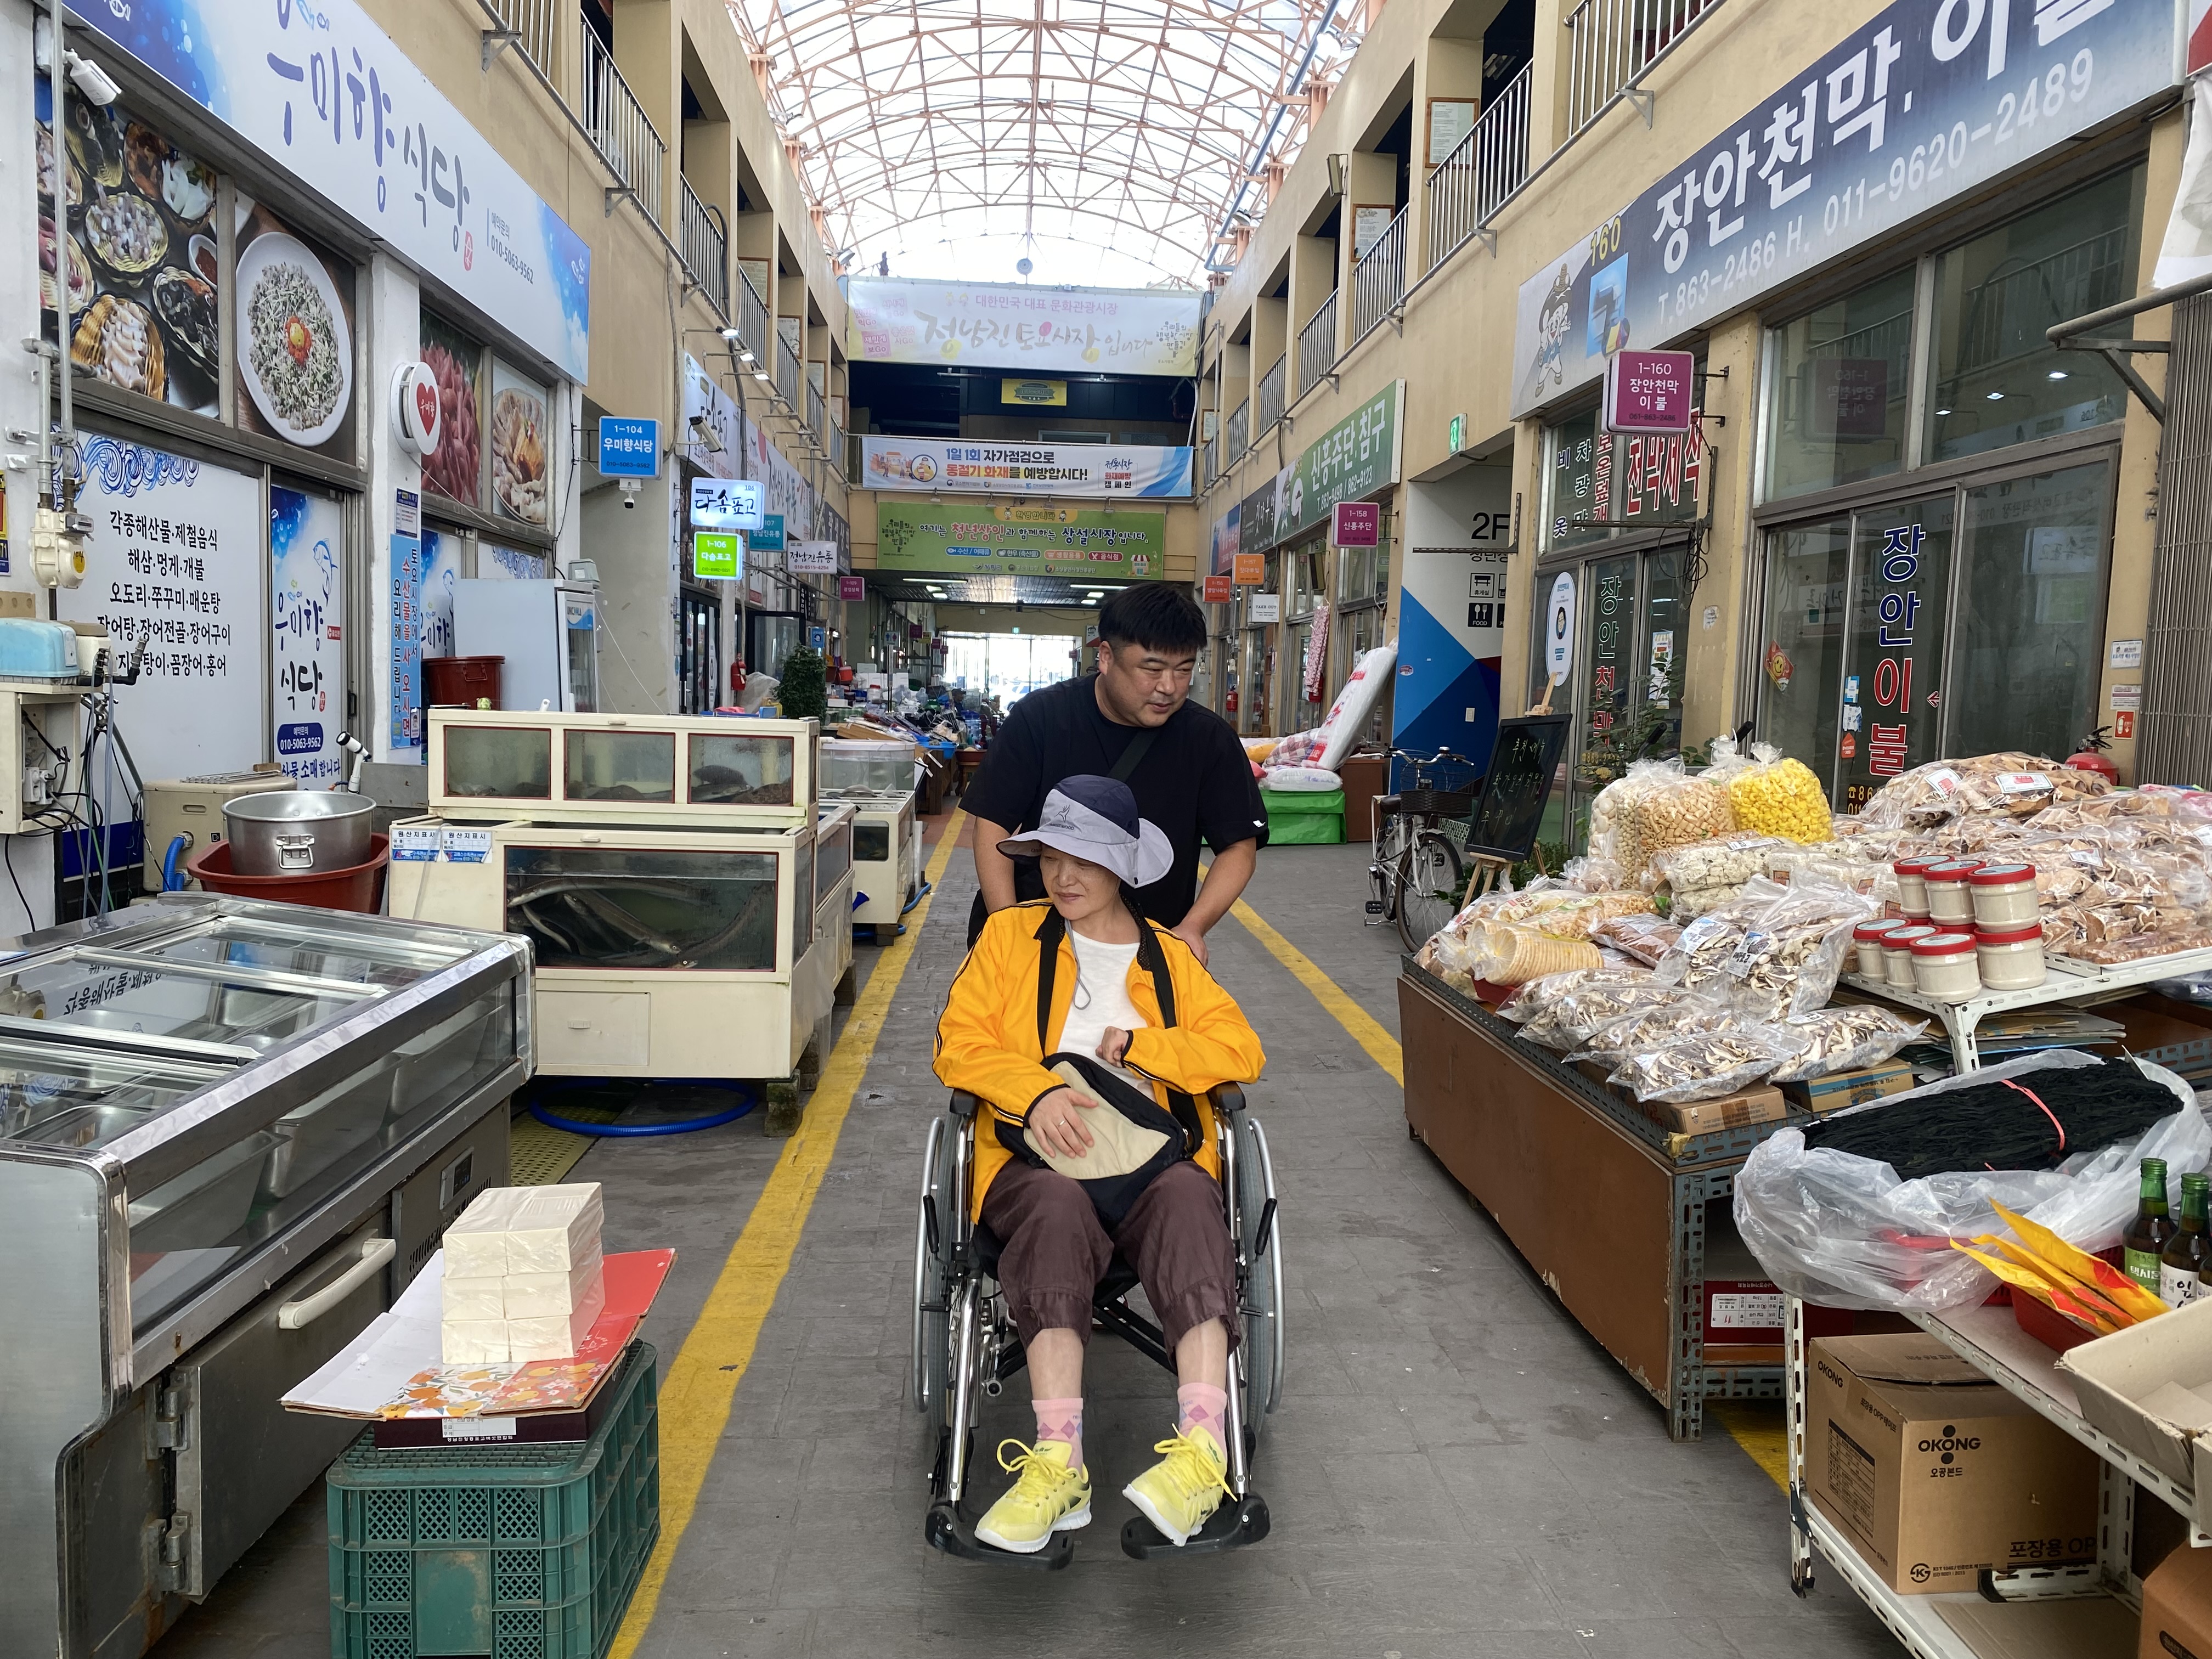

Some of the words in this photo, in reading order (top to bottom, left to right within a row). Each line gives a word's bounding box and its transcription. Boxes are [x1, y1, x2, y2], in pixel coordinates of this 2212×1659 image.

[404, 123, 470, 252] 식당
[1658, 230, 1777, 325] T.863-2486
[1786, 215, 1810, 258] H.
[1824, 47, 2094, 236] 011-9620-2489
[491, 212, 510, 241] 예약문의
[1590, 215, 1622, 267] 160
[491, 235, 534, 285] 010-5063-9562
[975, 294, 1021, 309] 대한민국
[1025, 297, 1046, 310] 대표
[1050, 298, 1118, 315] 문화관광시장
[864, 335, 887, 345] 재밌게
[913, 309, 1009, 354] 정남진
[1016, 321, 1101, 363] 토요시장
[1105, 329, 1153, 359] 입니다
[1638, 362, 1672, 375] 1-160
[1629, 378, 1679, 394] 장안천막
[420, 400, 435, 418] 우미향
[614, 425, 642, 434] 1-104
[603, 438, 653, 453] 우미향식당
[946, 448, 962, 461] 1일
[965, 449, 980, 461] 1회
[984, 449, 1054, 464] 자가점검으로
[946, 464, 981, 477] 동절기
[984, 465, 1021, 478] 화재를
[1024, 467, 1087, 481] 예방합시다!
[1104, 458, 1133, 471] 전통시장
[1104, 472, 1131, 481] 화재예방
[1347, 465, 1373, 495] 862-9123
[1104, 481, 1132, 489] 캠페인
[695, 489, 756, 515] 다솜표고
[1015, 510, 1056, 521] 환영합니다
[752, 529, 780, 538] 정남진유통
[919, 523, 946, 538] 여기는
[951, 522, 1015, 542] 청년상인과
[1019, 527, 1056, 541] 함께하는
[1344, 522, 1372, 531] 신흥주단
[1471, 512, 1510, 540] 2F
[707, 540, 726, 548] 1-106
[701, 552, 732, 561] 다솜표고
[790, 550, 833, 564] 정남진유통
[275, 592, 324, 651] 우미향
[1869, 523, 1926, 777] 장안이불
[281, 660, 323, 711] 식당
[280, 737, 321, 750] 010-5063-9562
[1724, 1314, 1731, 1324] 11
[1818, 1360, 1843, 1389] OKONG
[1860, 1397, 1872, 1414] 포장용
[1873, 1408, 1883, 1421] OPP
[1883, 1417, 1897, 1432] 테이프
[1918, 1437, 1982, 1453] OKONG
[1930, 1467, 1963, 1478] 오공본드
[2009, 1539, 2063, 1559] 포장용
